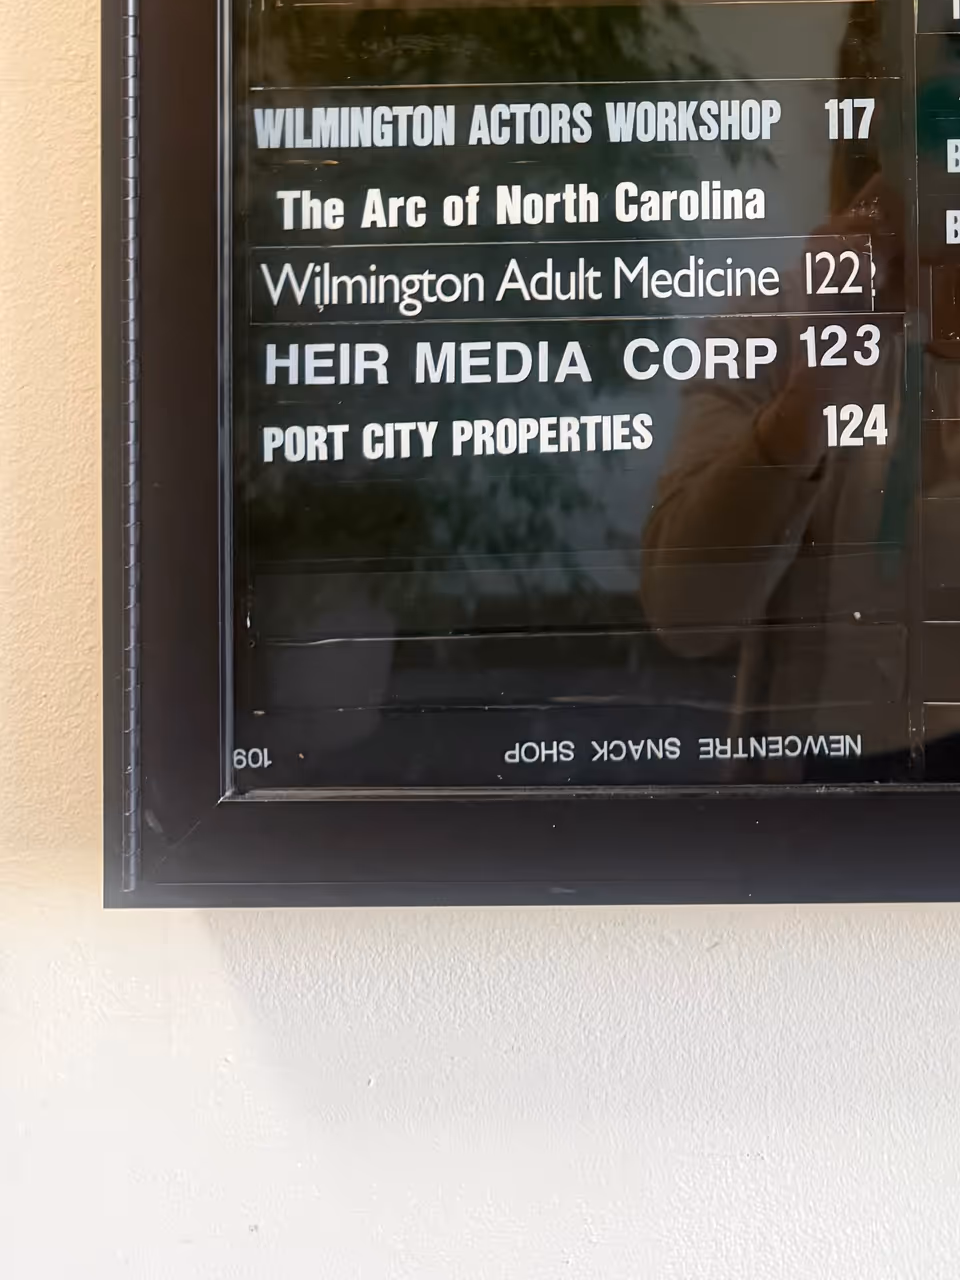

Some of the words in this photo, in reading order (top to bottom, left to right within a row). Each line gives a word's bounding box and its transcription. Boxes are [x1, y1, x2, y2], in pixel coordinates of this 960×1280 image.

[255, 104, 455, 149] WILMINGTON
[469, 102, 592, 145] ACTORS
[605, 99, 782, 143] WORKSHOP
[825, 98, 875, 140] 117
[276, 190, 344, 230] The
[362, 188, 426, 228] Arc
[443, 186, 479, 226] of
[496, 183, 598, 225] North
[615, 180, 765, 222] Carolina
[261, 262, 484, 316] Wilmington
[497, 258, 602, 302] Adult
[614, 256, 779, 299] Medicine
[805, 251, 862, 296] 122
[265, 342, 388, 386] HEIR
[415, 341, 592, 384] MEDIA
[623, 337, 777, 381] CORP
[800, 324, 880, 368] 123
[263, 424, 349, 463] PORT
[363, 421, 438, 460] CITY
[452, 413, 653, 456] PROPERTIES
[823, 403, 888, 447] 124
[233, 747, 272, 770] 109
[504, 739, 575, 763] SHOP
[591, 737, 680, 761] SNACK
[699, 735, 861, 759] NEWCENTRE
